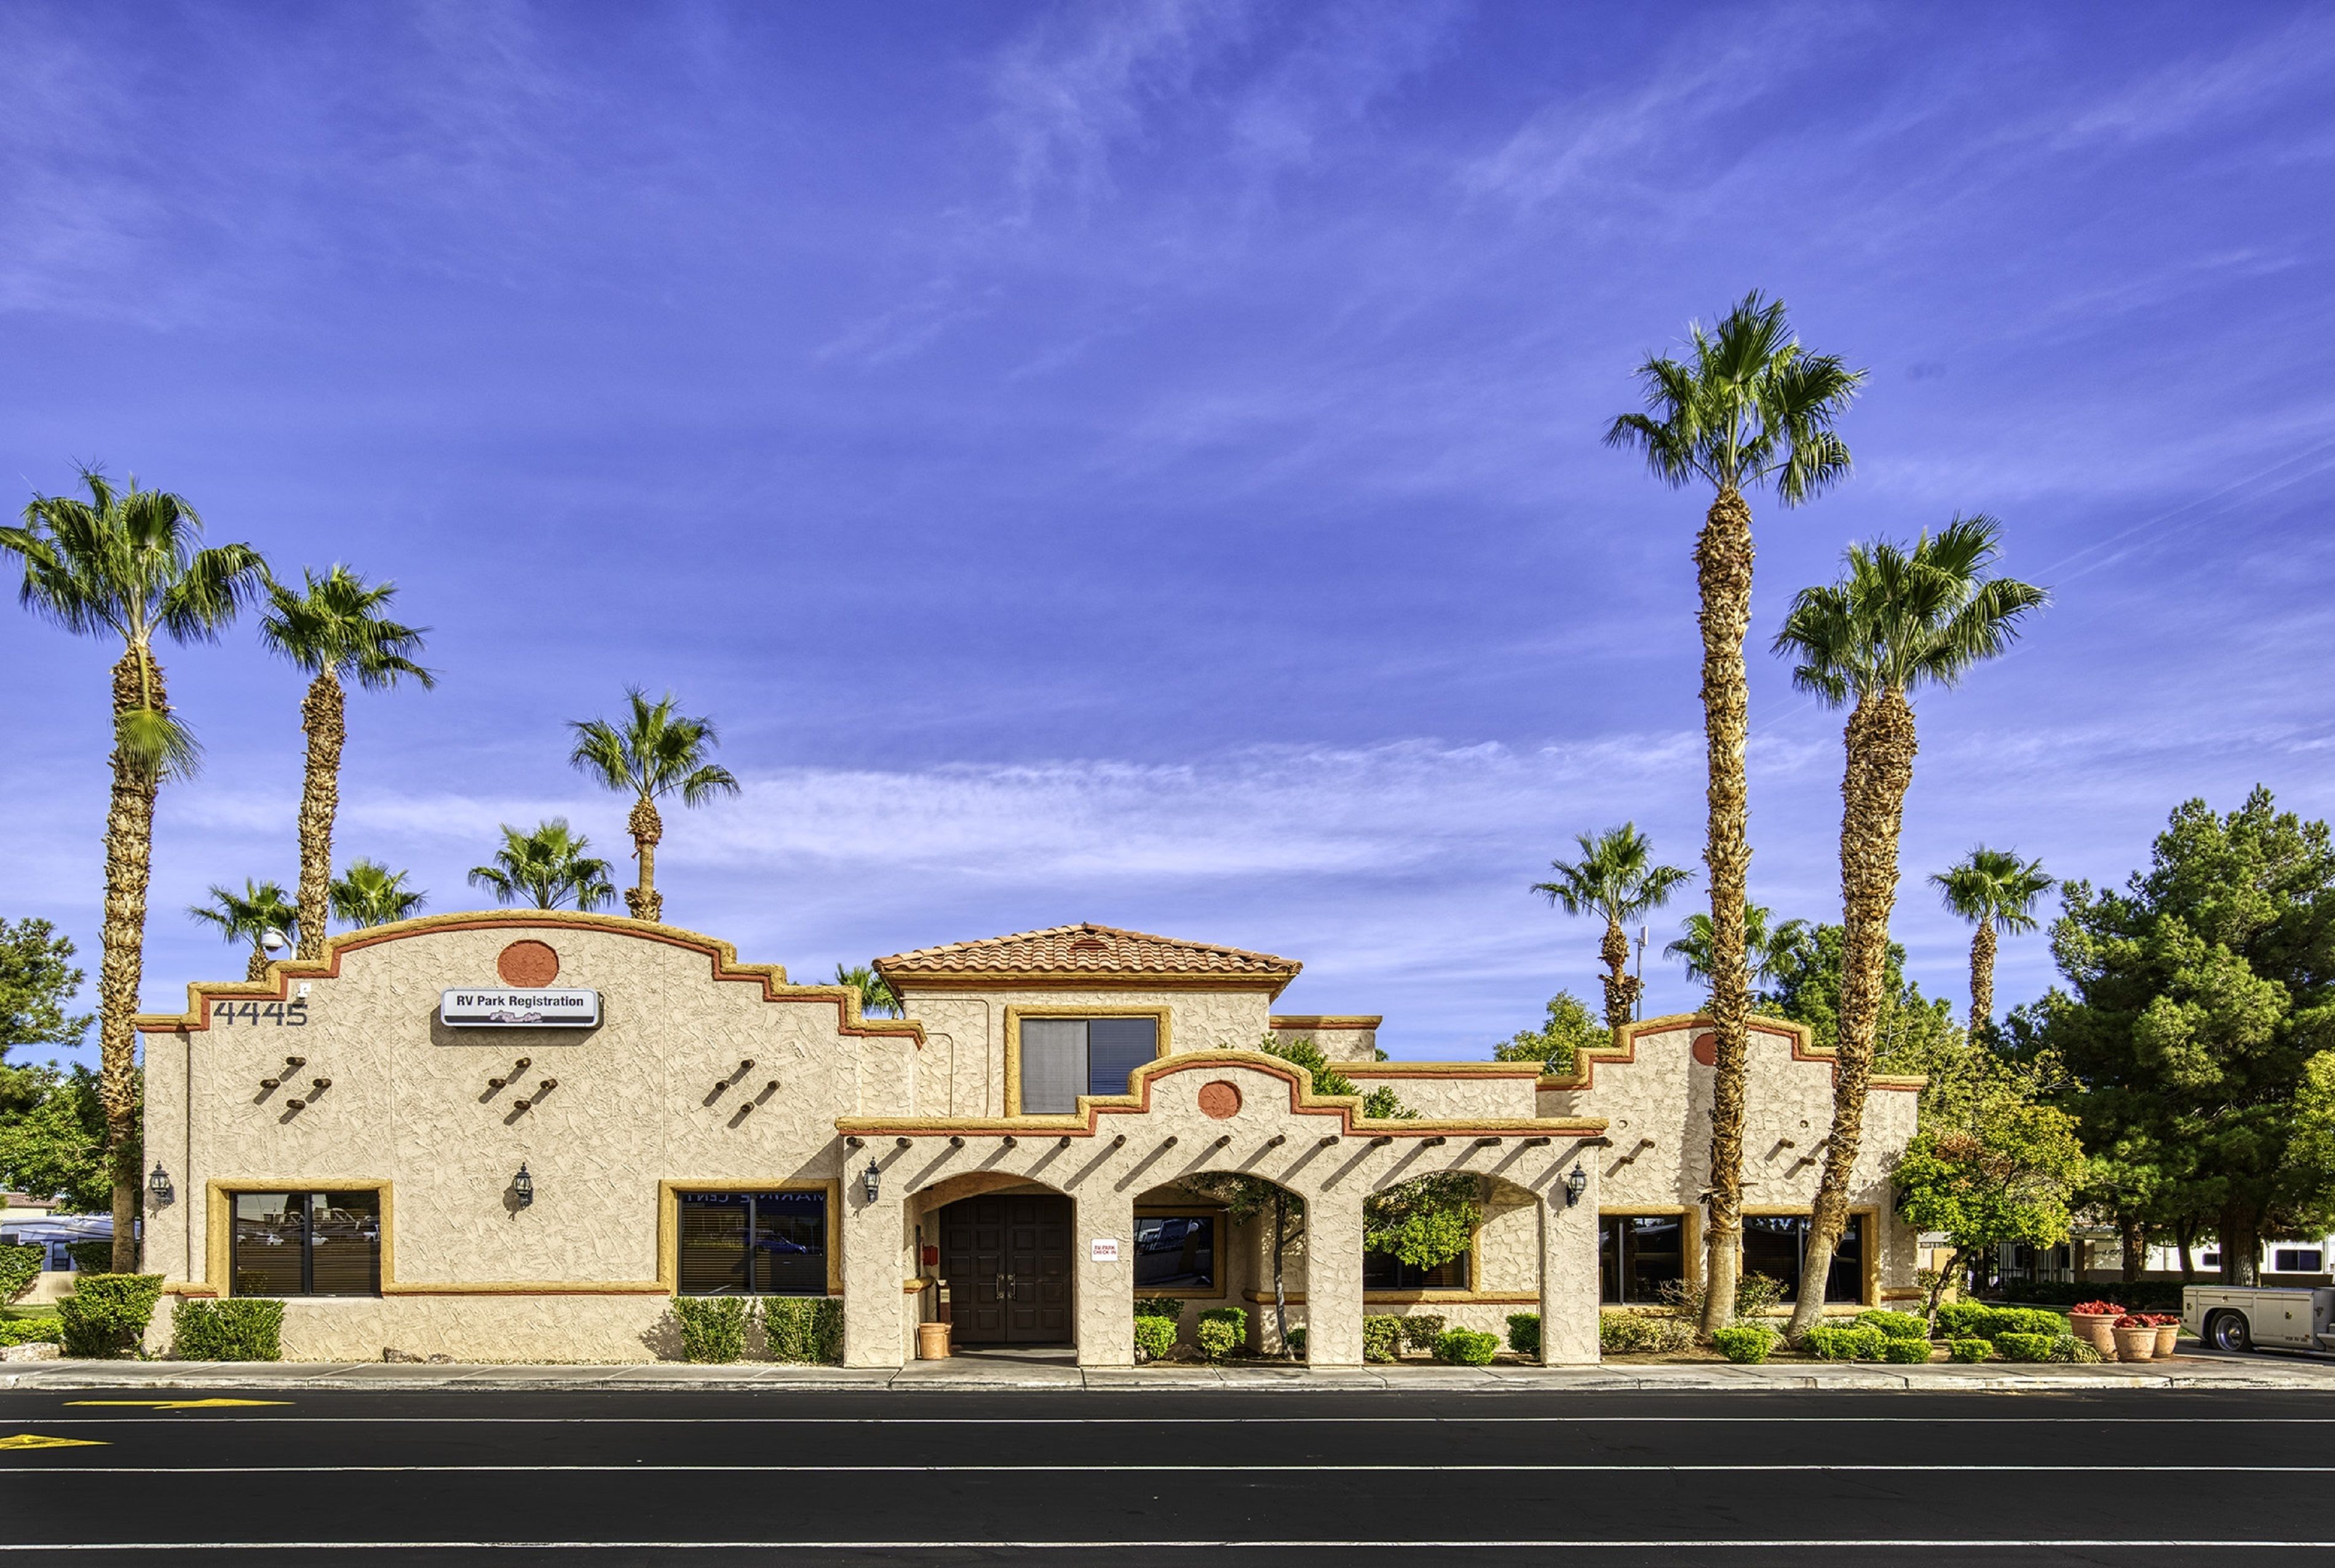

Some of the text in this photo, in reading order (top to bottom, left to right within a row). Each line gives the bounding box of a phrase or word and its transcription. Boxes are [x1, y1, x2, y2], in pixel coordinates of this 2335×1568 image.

[457, 996, 584, 1008] RV Park Registration
[213, 1002, 308, 1026] 4445
